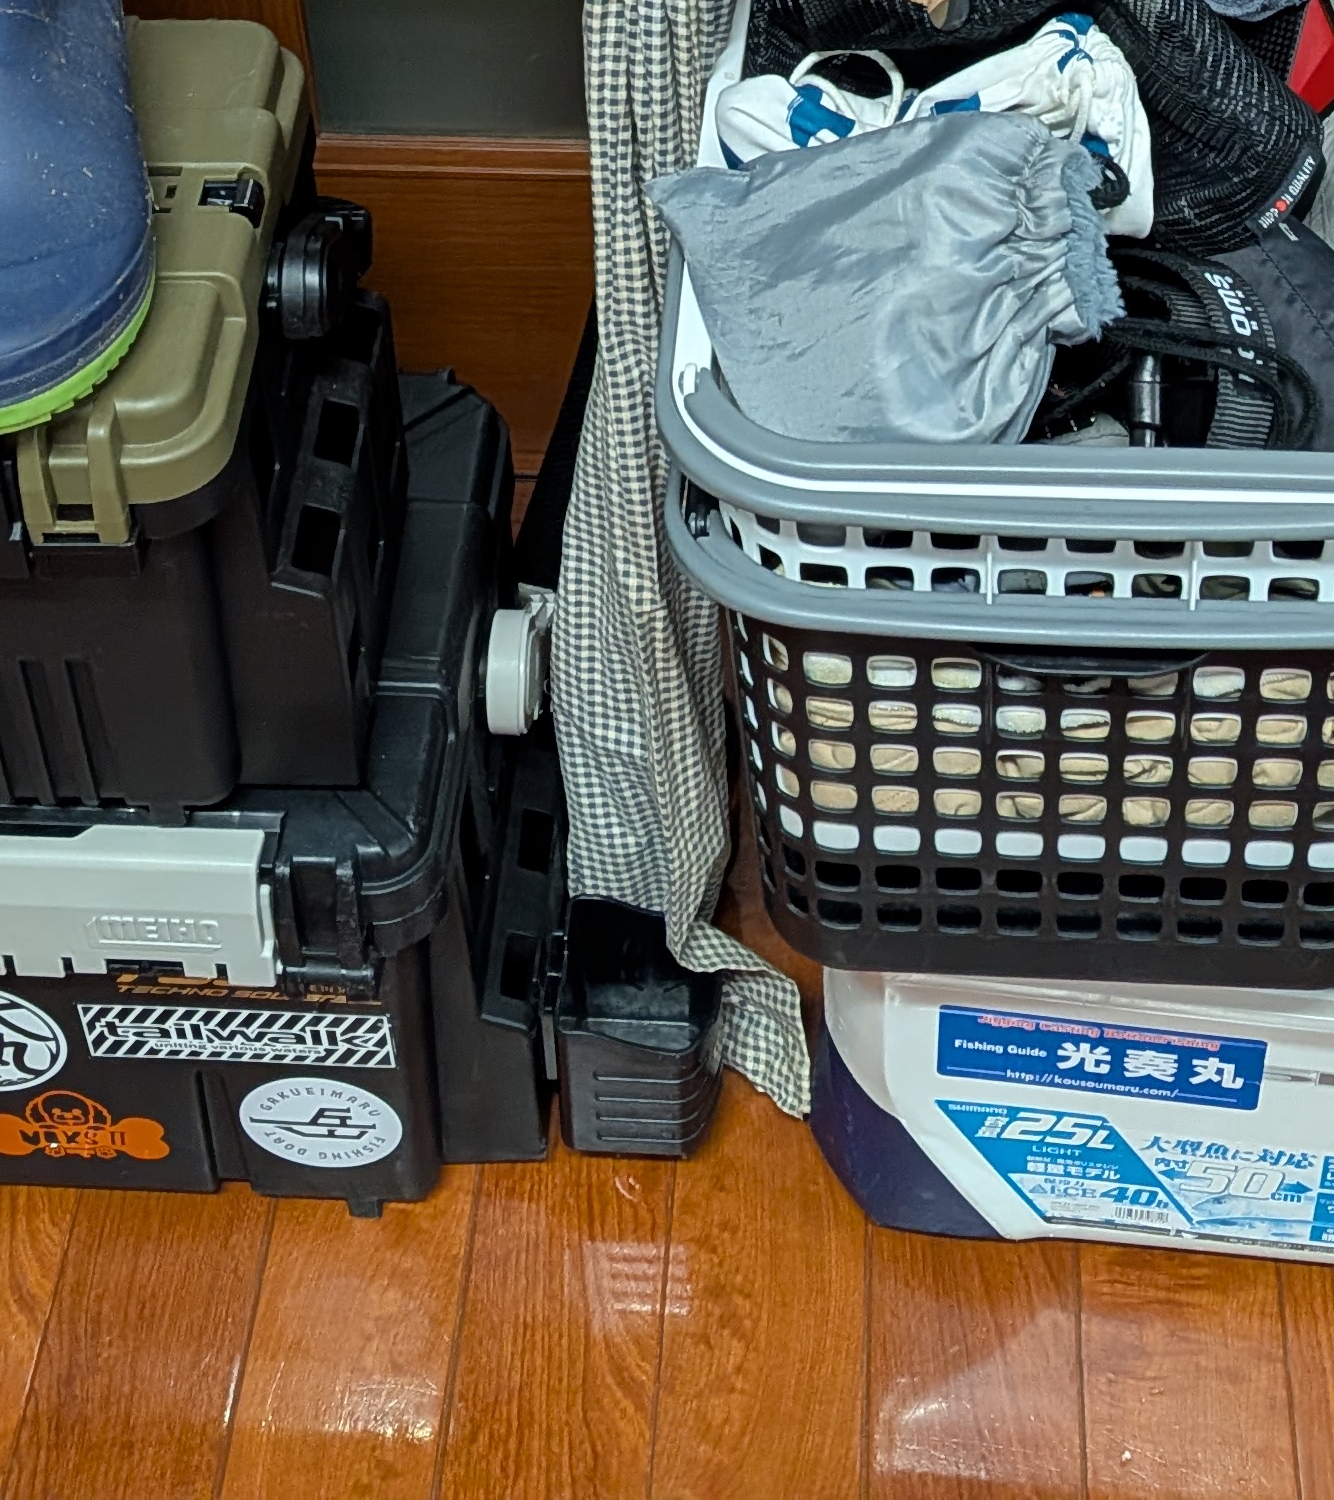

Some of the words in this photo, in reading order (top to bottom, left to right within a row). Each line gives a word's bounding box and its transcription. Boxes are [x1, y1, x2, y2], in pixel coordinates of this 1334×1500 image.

[98, 915, 219, 942] MEIHO
[116, 984, 229, 998] TECHNO
[95, 1017, 382, 1050] tailwalk
[210, 1043, 268, 1053] various
[954, 1039, 1004, 1055] Fishing
[1007, 1045, 1047, 1058] Guide
[1057, 1042, 1246, 1090] 光奏丸
[1006, 1069, 1179, 1098] http://kousoumaru.com/
[259, 1086, 382, 1118] GAKUEIMARU
[1000, 1112, 1115, 1150] 25L
[318, 1136, 387, 1161] FISHING
[1031, 1145, 1083, 1157] LIGHT
[1141, 1135, 1317, 1170] 大型魚に対応
